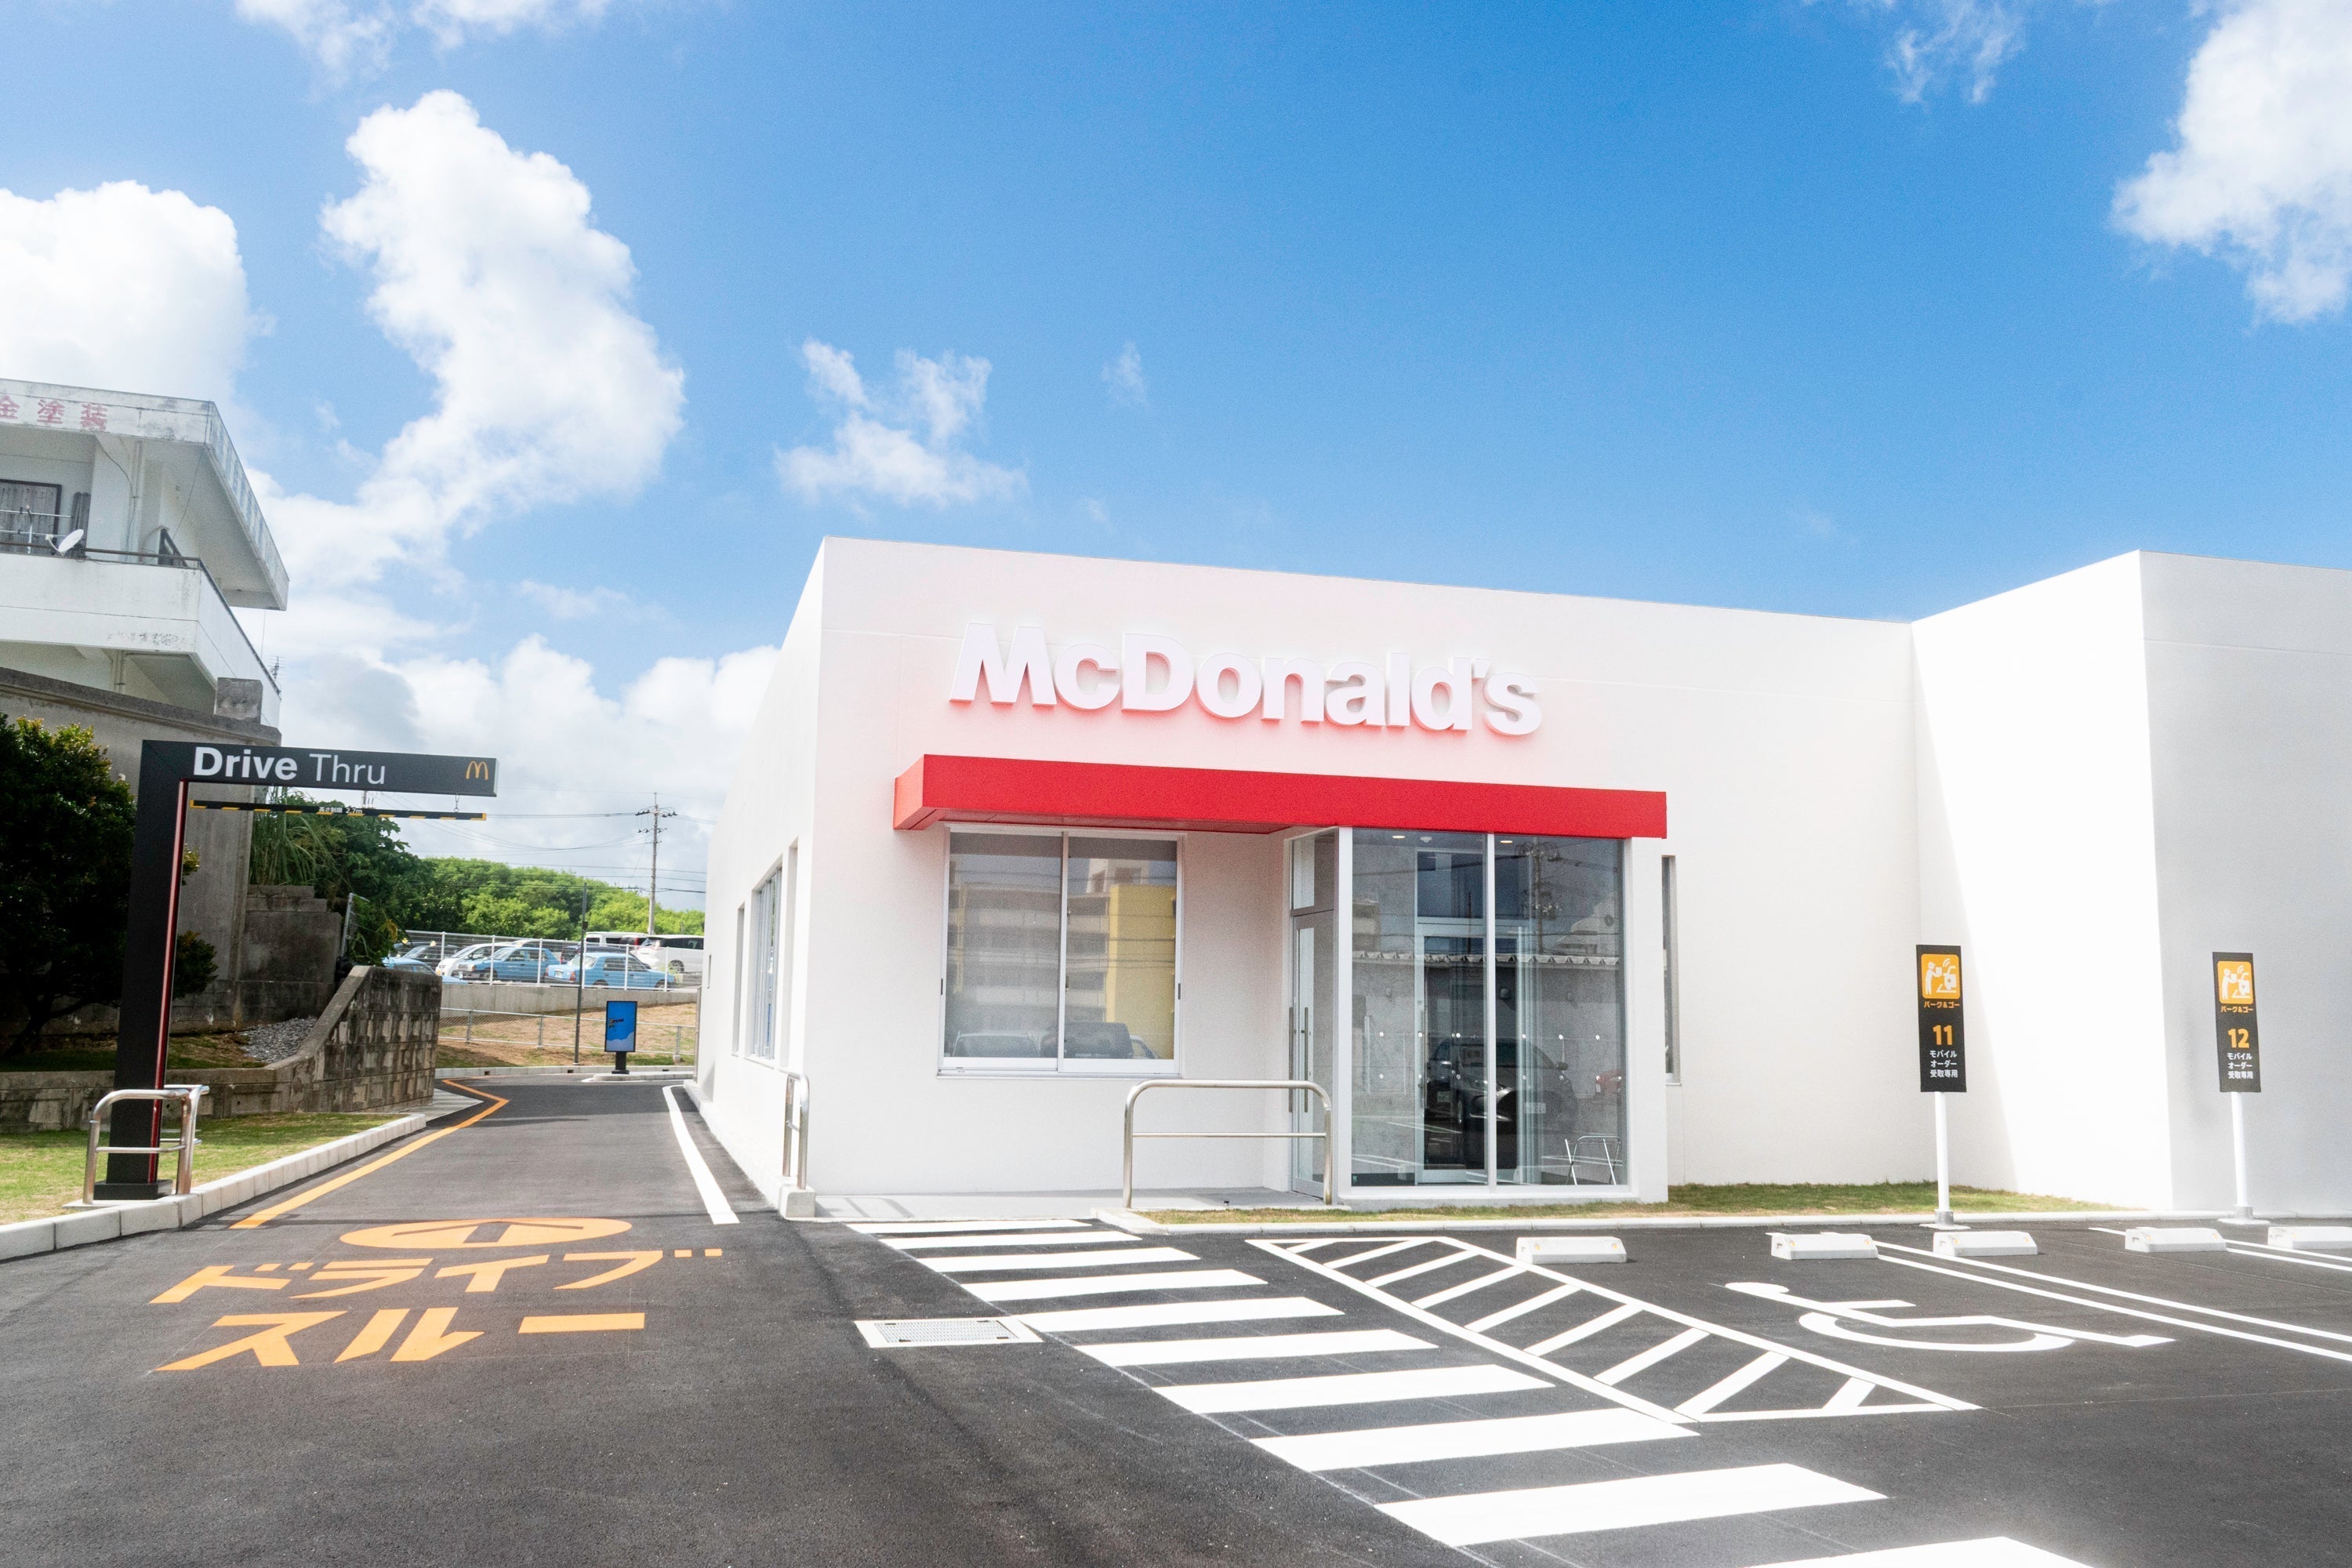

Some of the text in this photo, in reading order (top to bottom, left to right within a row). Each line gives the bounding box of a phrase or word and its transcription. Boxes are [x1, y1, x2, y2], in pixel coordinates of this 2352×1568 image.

[948, 622, 1542, 735] McDonald's
[193, 746, 385, 785] Drive Thru
[1933, 1025, 1953, 1046] 11
[2228, 1028, 2250, 1048] 12
[1929, 1050, 1958, 1058] モバイル
[1930, 1059, 1958, 1068] オーダー
[2227, 1052, 2252, 1061] モバイル
[1929, 1069, 1958, 1078] 受取専用
[2227, 1071, 2253, 1080] 受取専用
[149, 1248, 723, 1304] ドライブ
[155, 1308, 645, 1371] スルー
